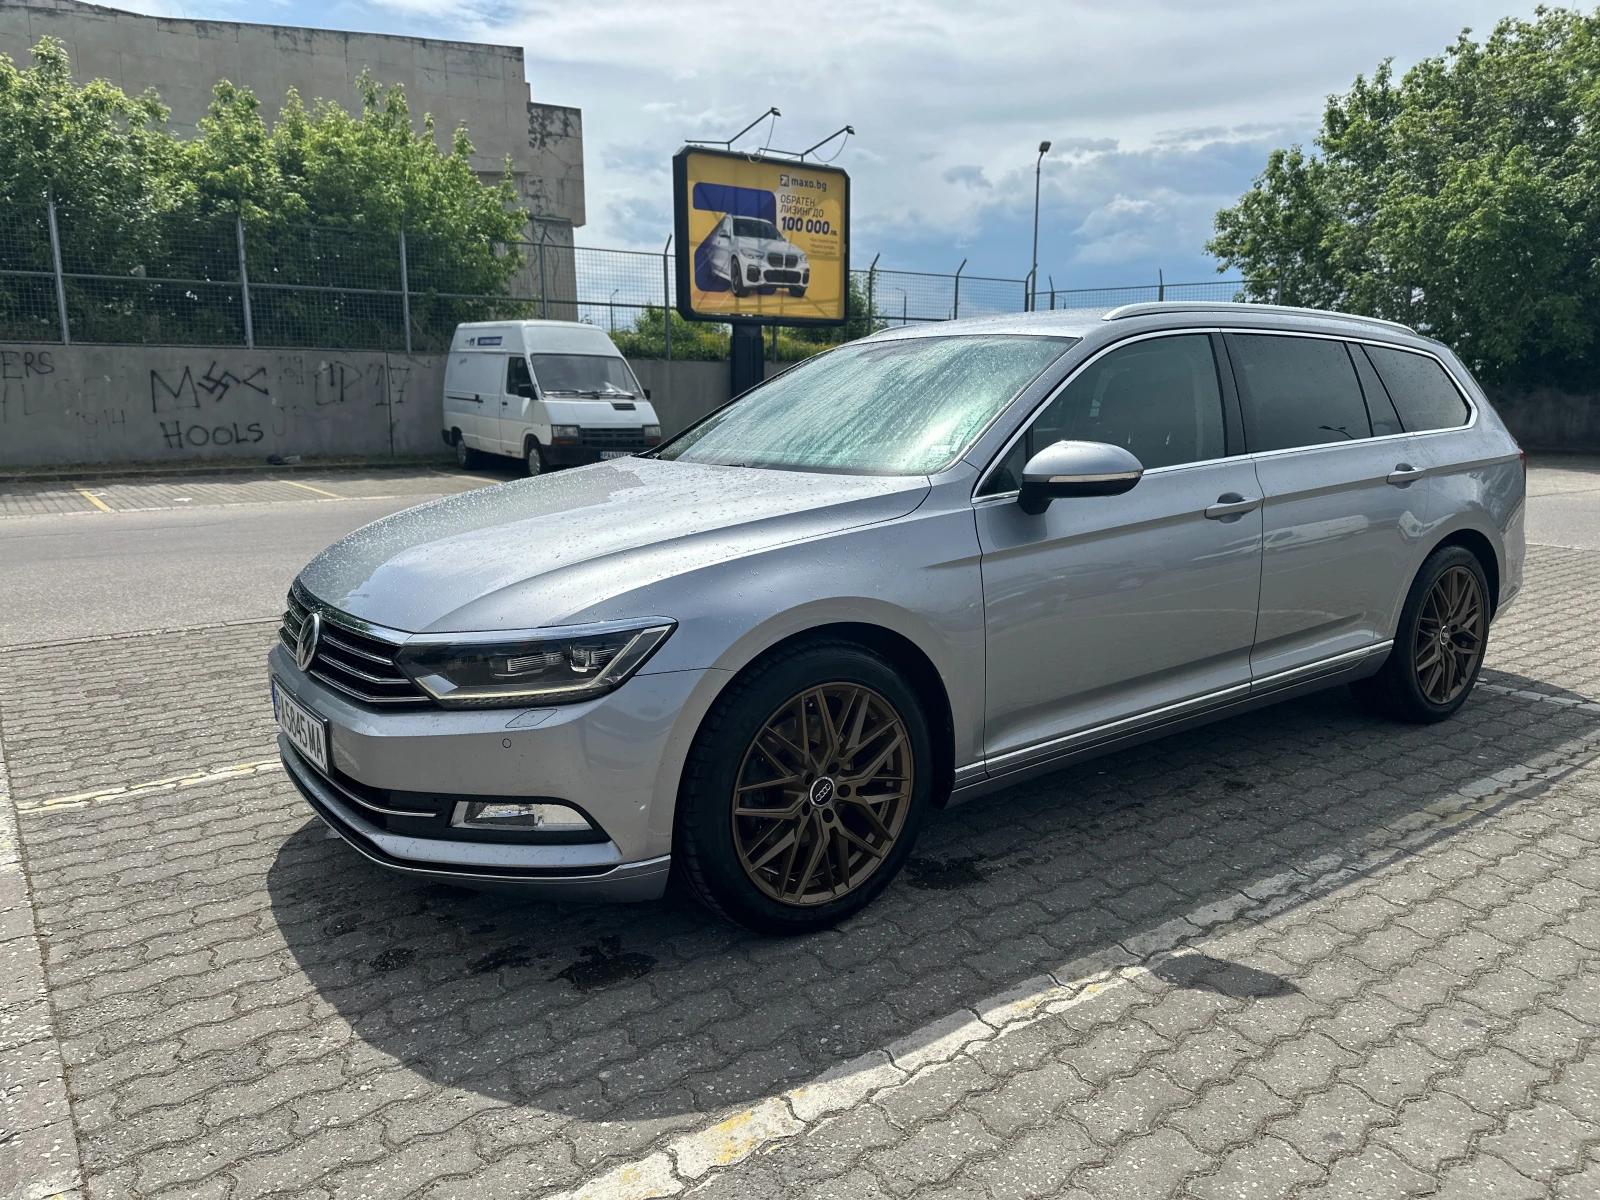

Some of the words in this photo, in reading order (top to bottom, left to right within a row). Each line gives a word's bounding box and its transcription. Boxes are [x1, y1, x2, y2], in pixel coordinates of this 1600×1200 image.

[791, 178, 827, 192] maxo.bg
[780, 194, 816, 207] ОБРАТЕН
[780, 204, 812, 216] ЛИЗИНГ
[812, 208, 824, 218] ДО
[781, 215, 803, 232] 100
[805, 219, 830, 235] 000
[159, 420, 265, 449] HOOLS
[275, 689, 325, 763] PA5845MA
